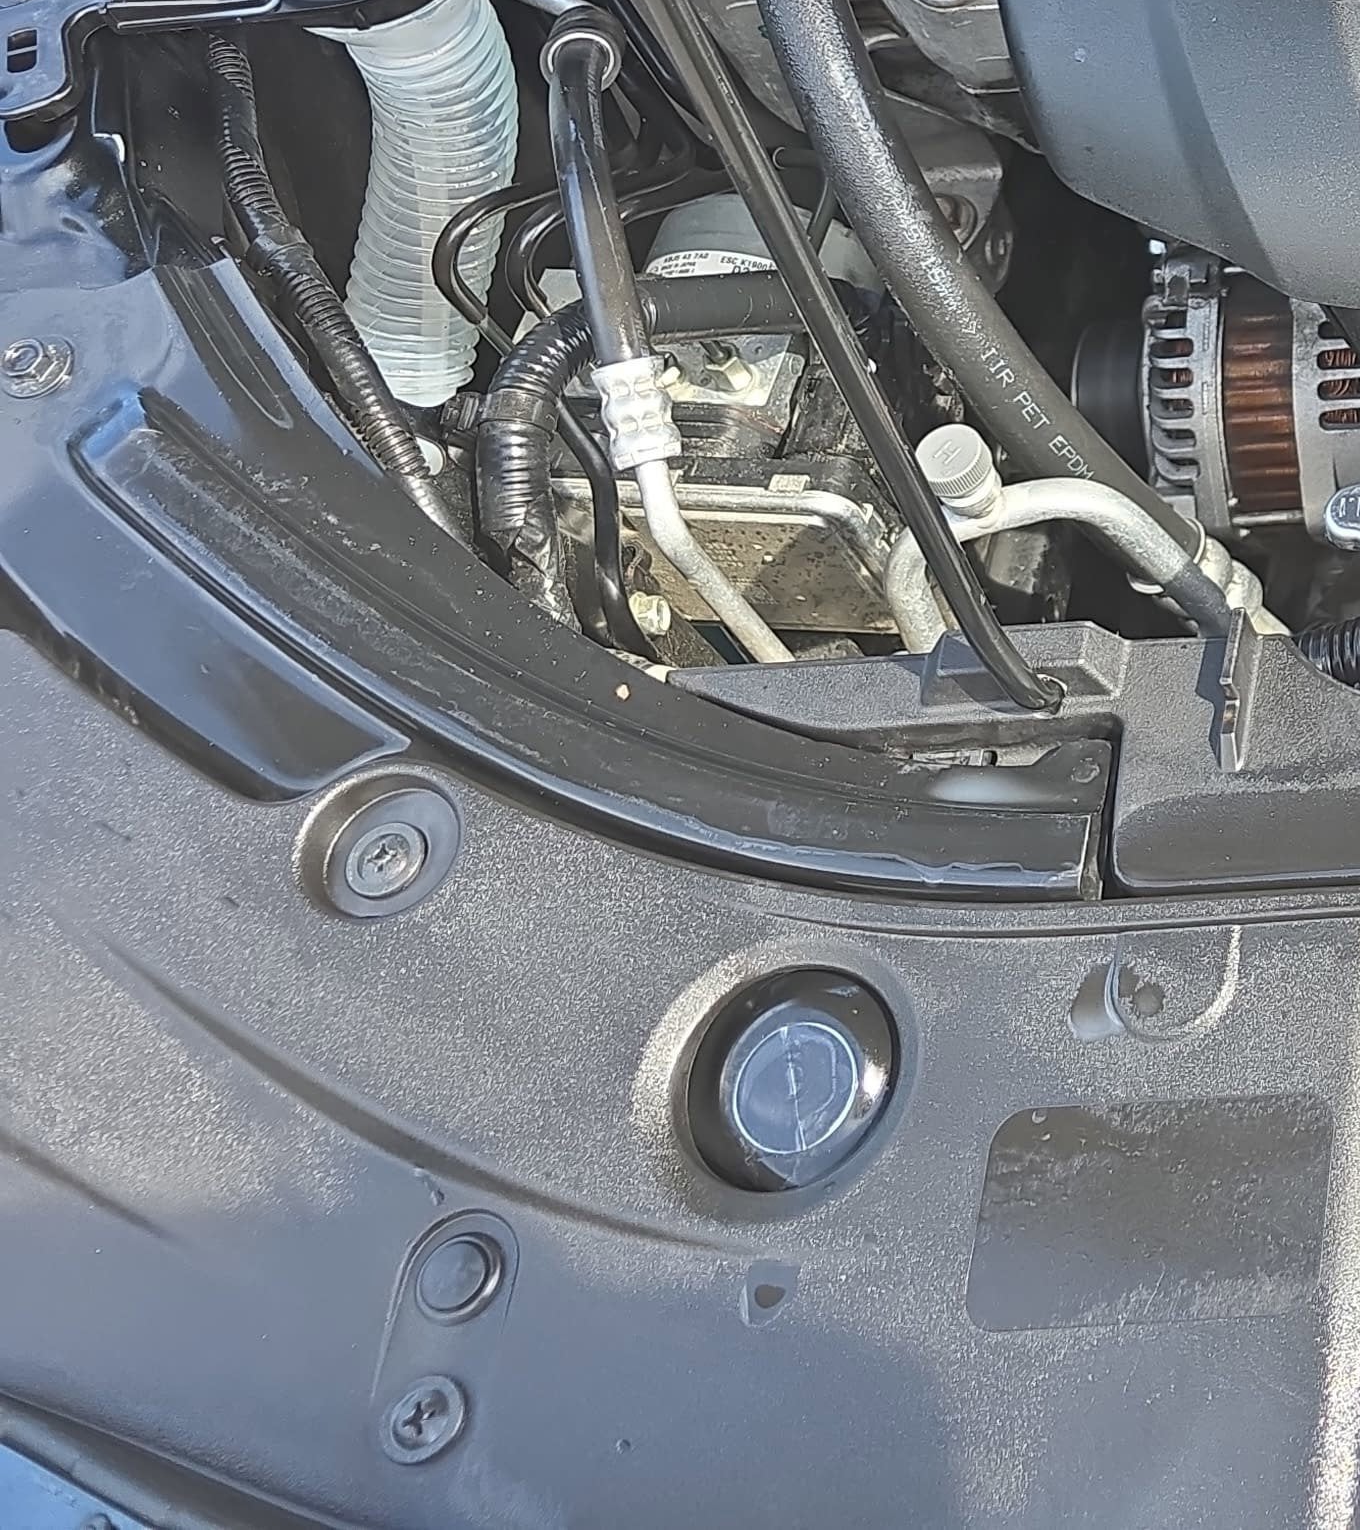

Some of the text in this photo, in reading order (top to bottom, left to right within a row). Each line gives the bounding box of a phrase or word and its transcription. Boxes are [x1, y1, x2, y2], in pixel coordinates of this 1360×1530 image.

[720, 256, 738, 265] ESC
[981, 347, 1016, 389] IIR
[1014, 390, 1051, 430] PET
[1048, 435, 1095, 481] EPDM
[932, 440, 962, 464] H
